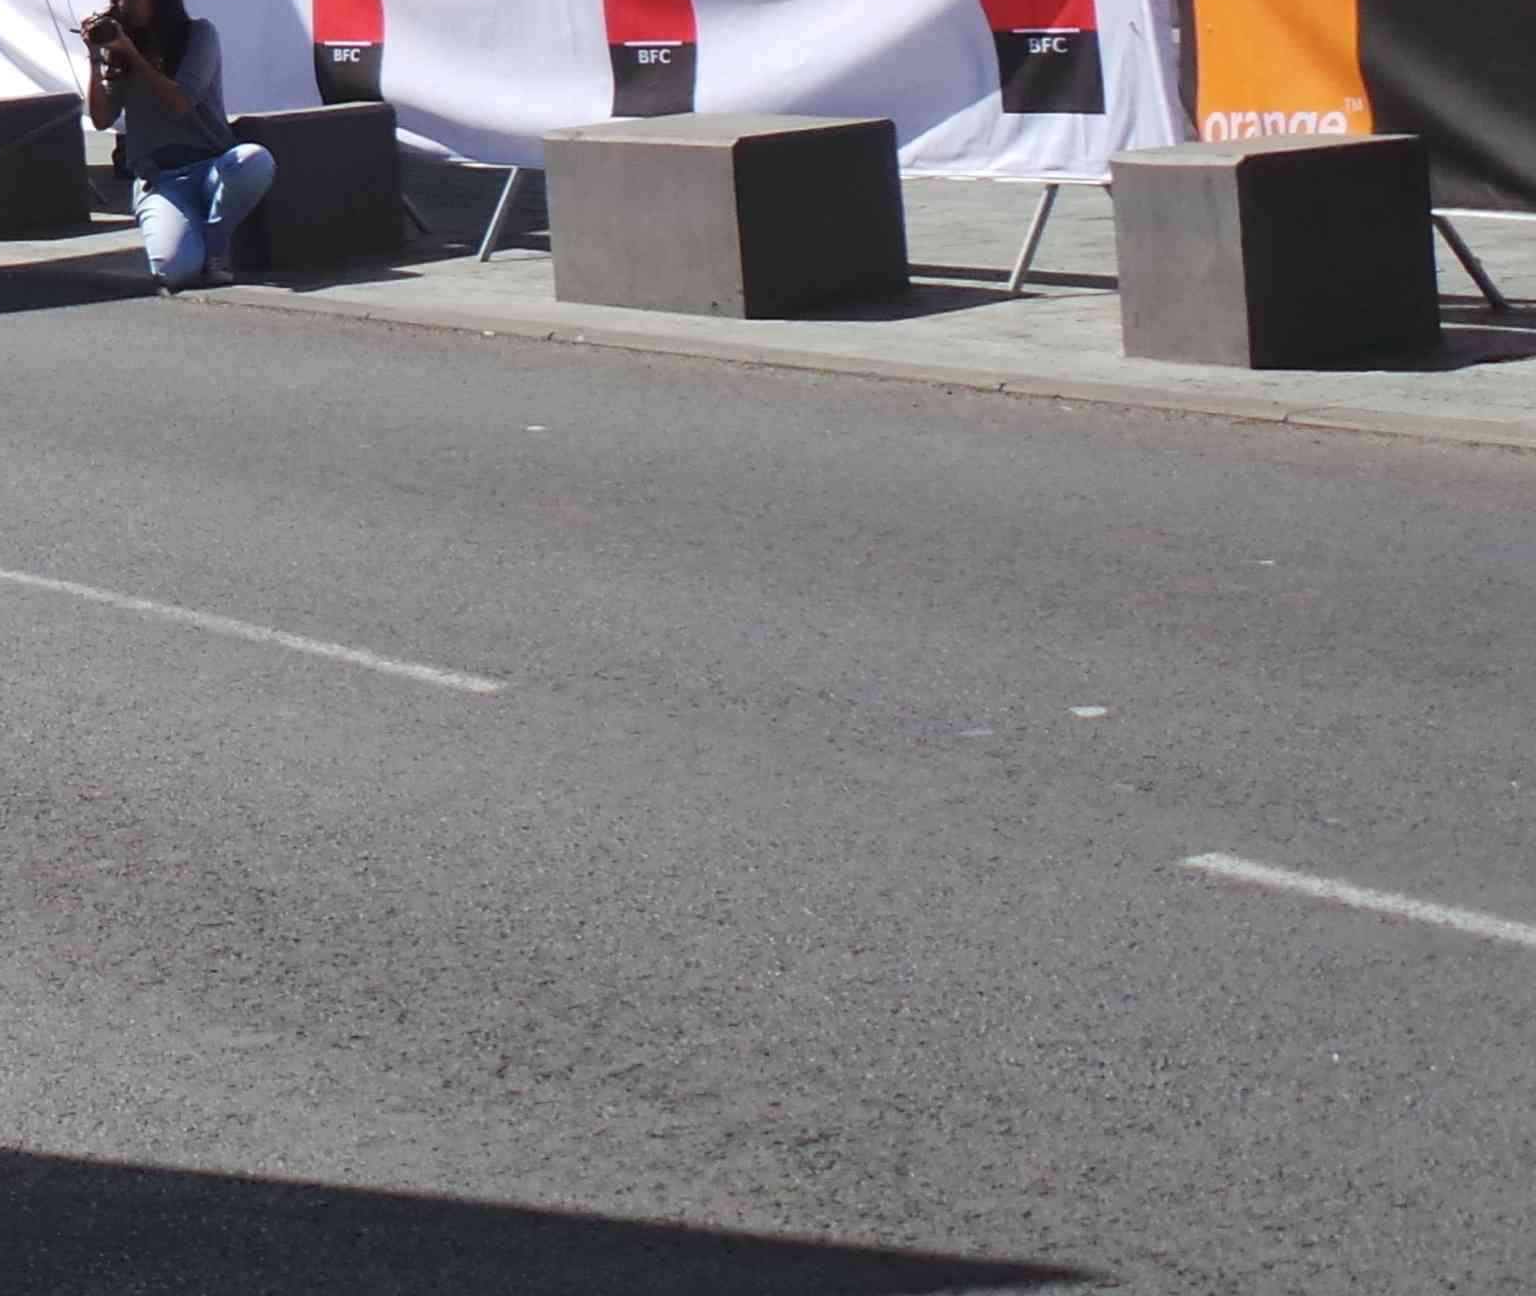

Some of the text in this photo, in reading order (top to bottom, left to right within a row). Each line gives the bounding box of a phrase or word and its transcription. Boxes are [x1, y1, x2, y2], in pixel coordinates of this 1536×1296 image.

[1028, 36, 1069, 54] BFC
[333, 47, 361, 63] BFC
[638, 48, 672, 64] BFC
